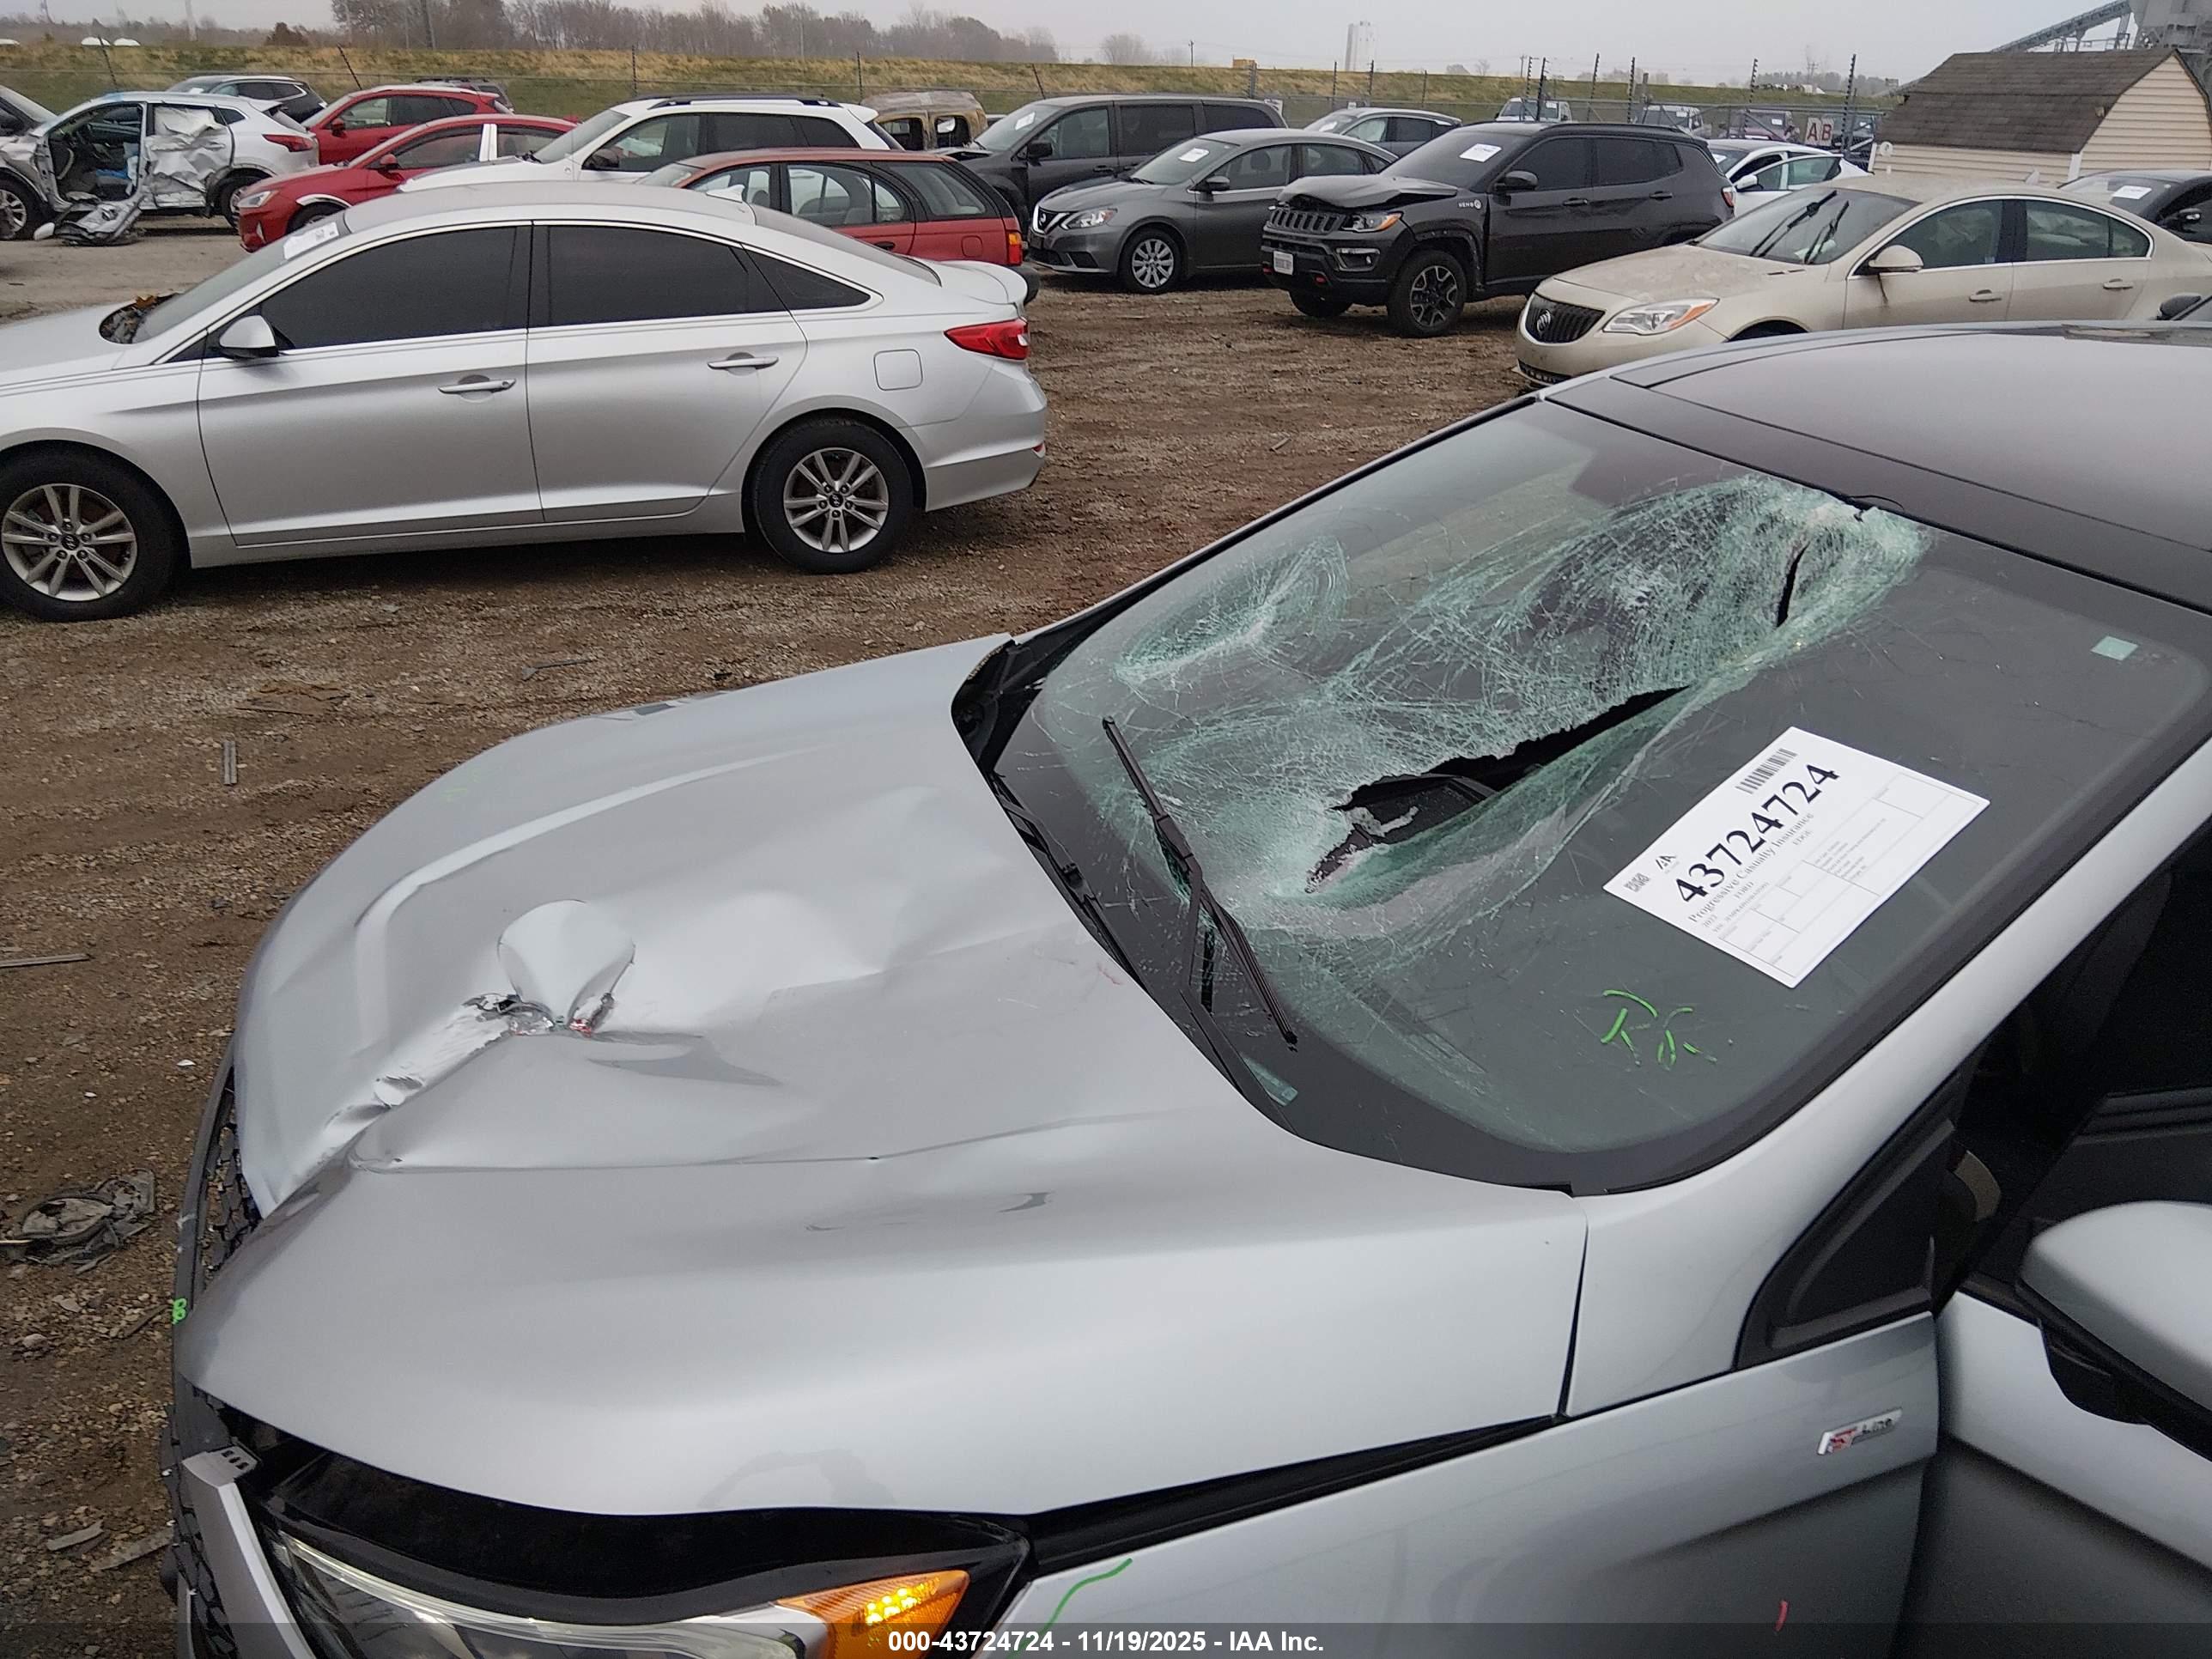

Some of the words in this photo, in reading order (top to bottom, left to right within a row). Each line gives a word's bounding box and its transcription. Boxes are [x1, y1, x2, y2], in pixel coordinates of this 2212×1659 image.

[1675, 763, 1841, 903] 43724724
[1687, 878, 1740, 923] Progressive
[1735, 848, 1777, 879] Casualty
[1771, 812, 1814, 848] Insurance
